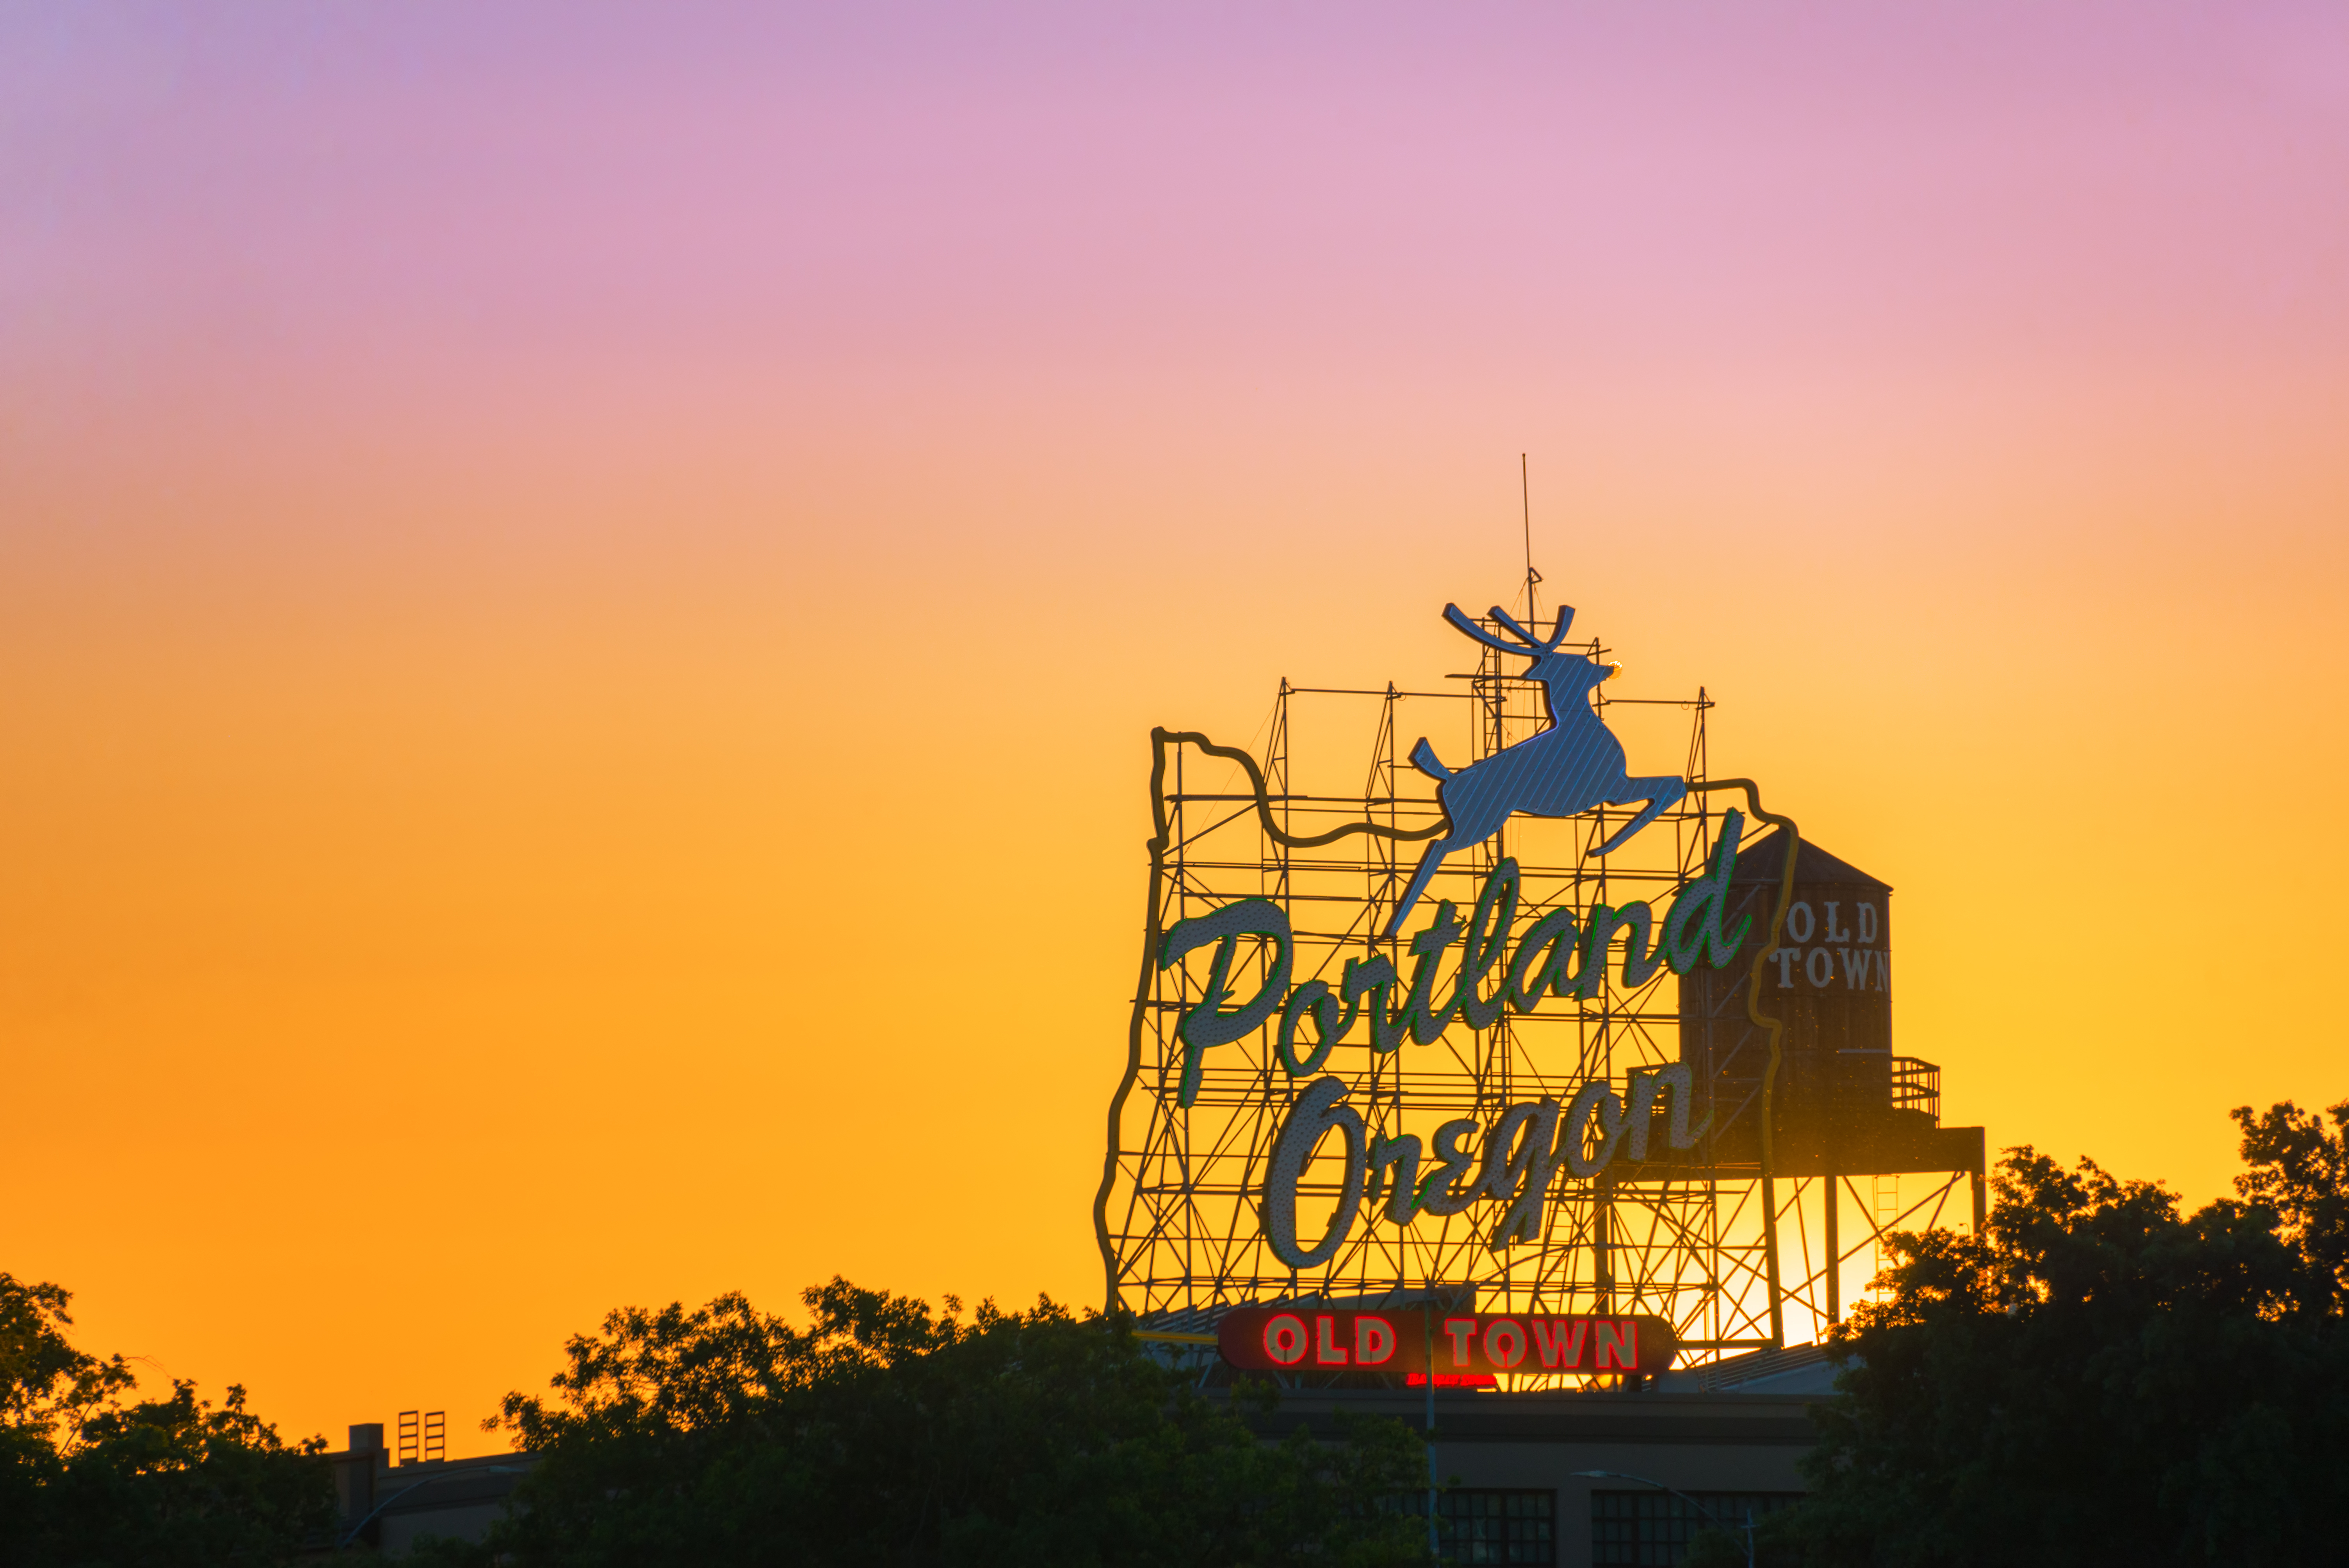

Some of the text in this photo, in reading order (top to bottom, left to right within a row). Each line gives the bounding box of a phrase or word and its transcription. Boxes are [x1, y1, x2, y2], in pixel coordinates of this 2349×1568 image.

[1788, 902, 1878, 943] OLD
[1160, 807, 1753, 1109] Portland
[1769, 947, 1889, 992] TOWN
[1265, 1061, 1714, 1269] Oregon
[1263, 1314, 1638, 1370] OLD TOWN
